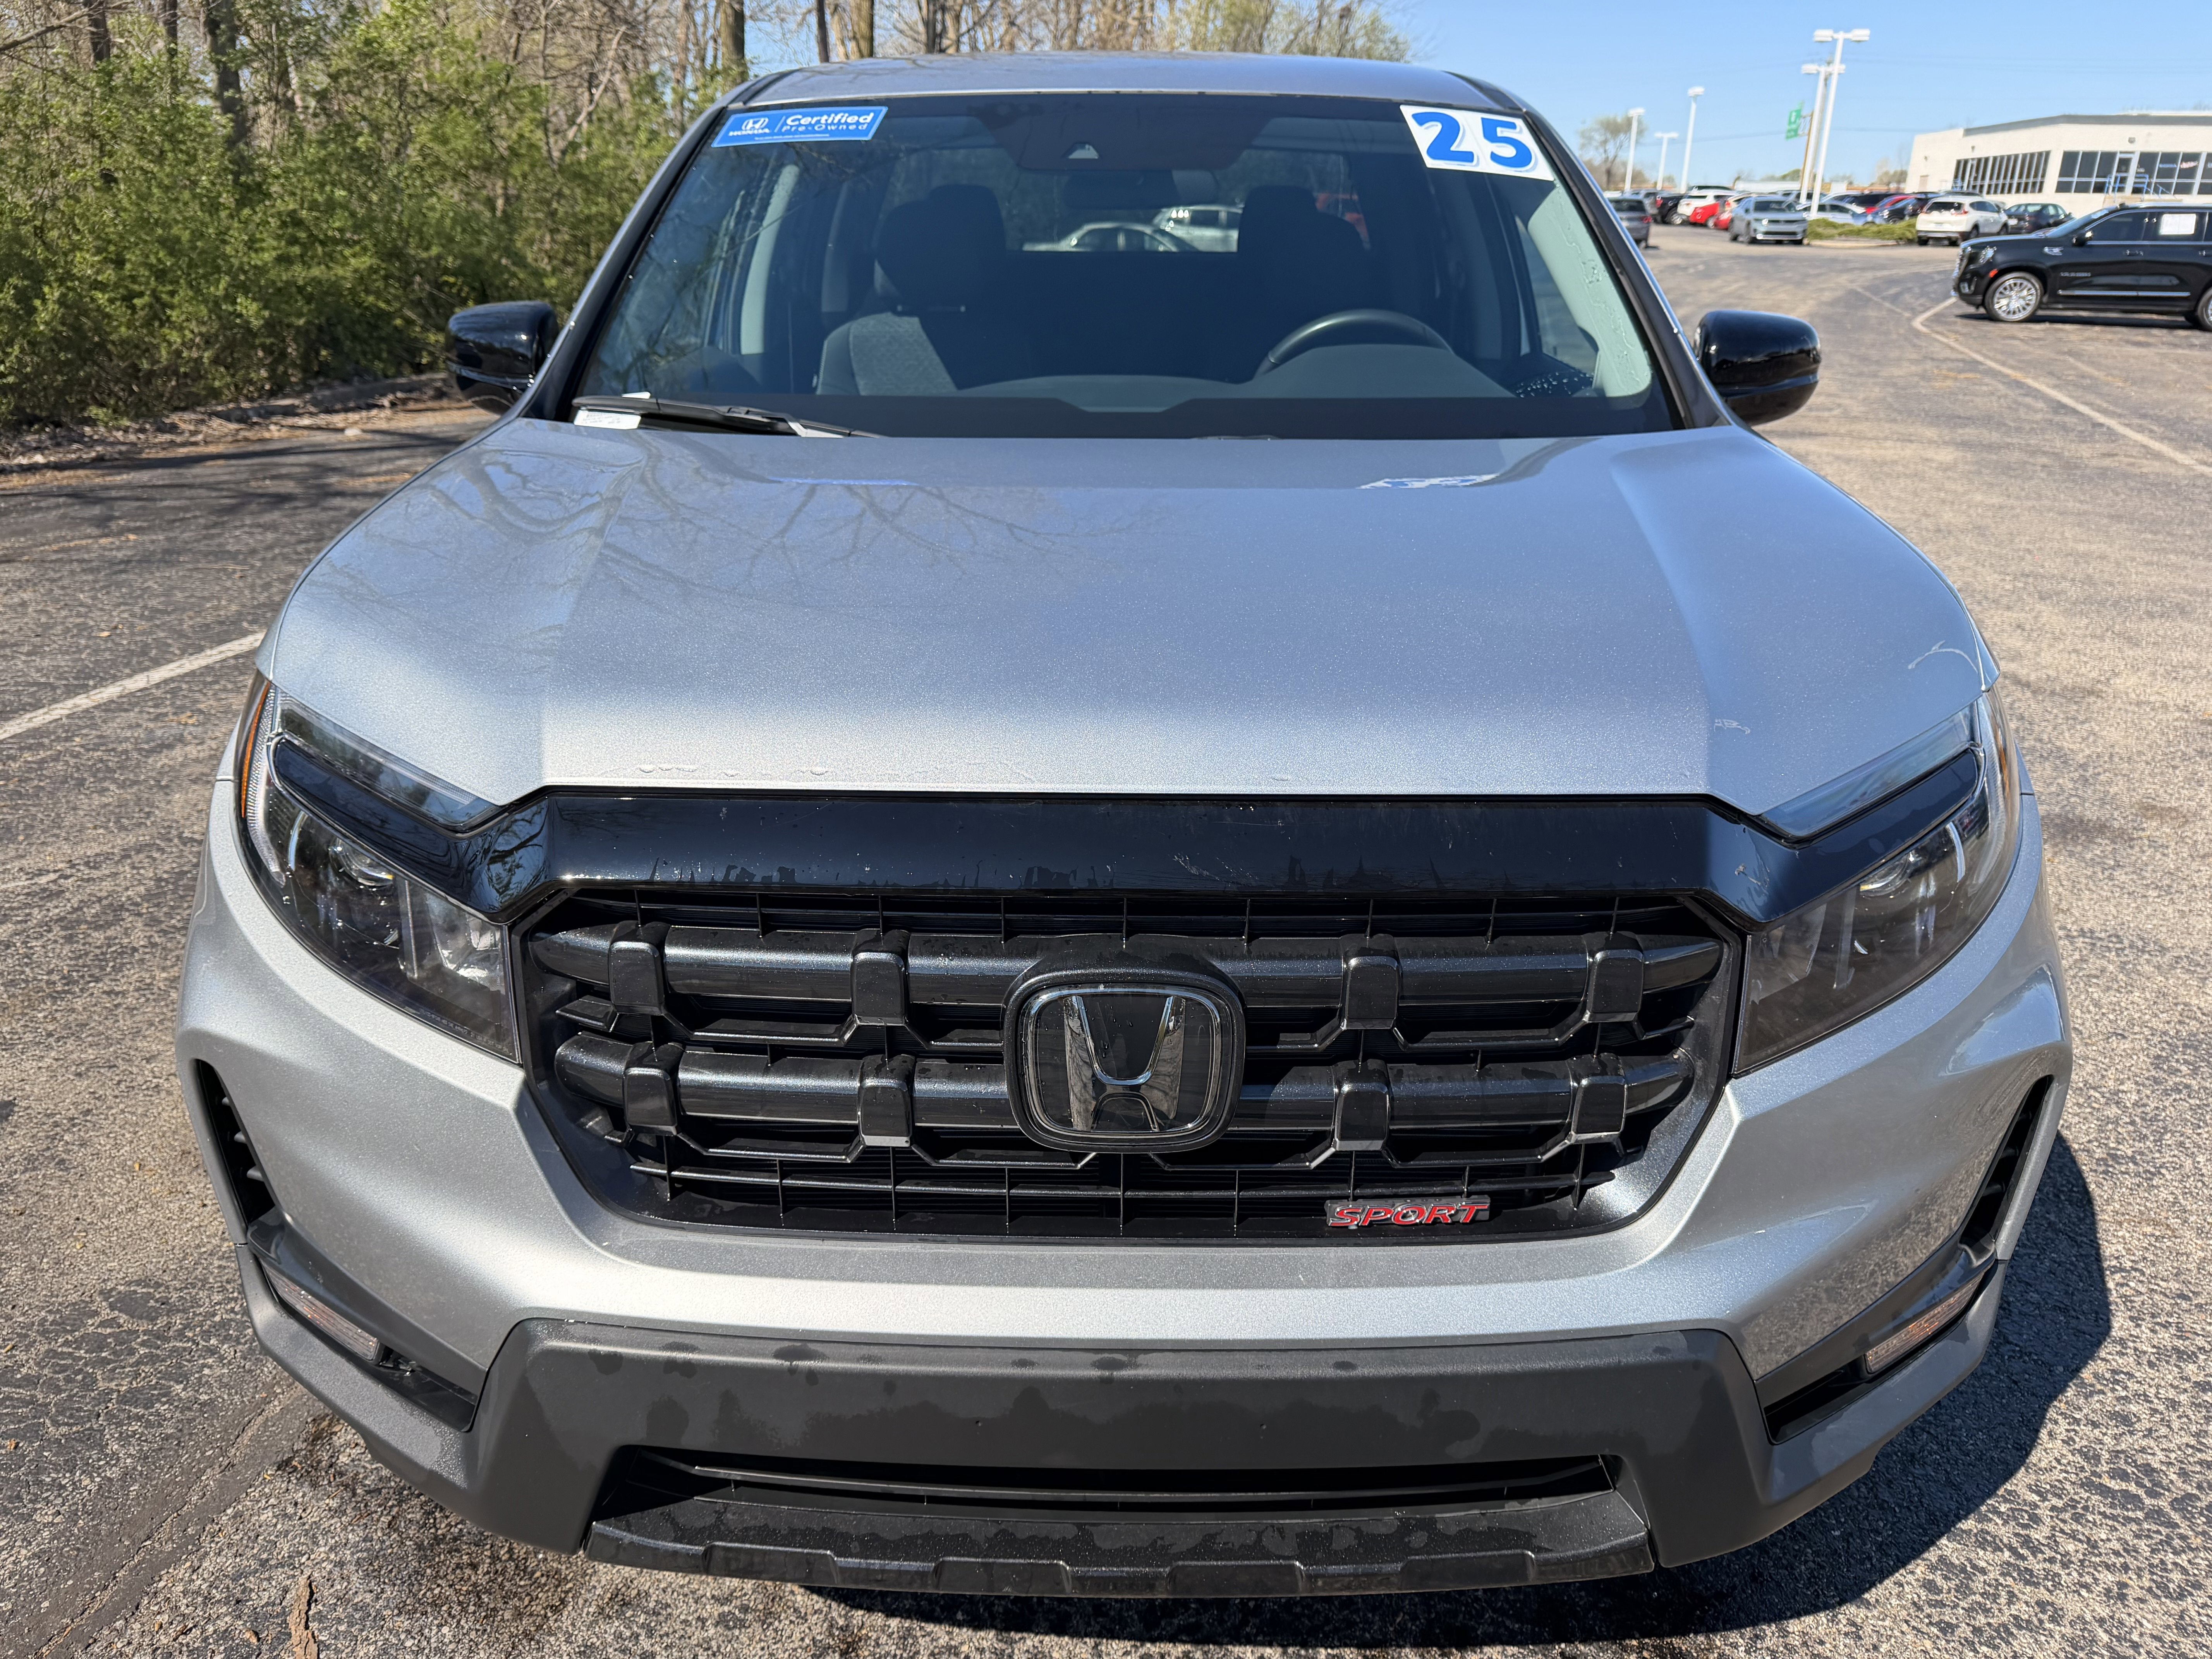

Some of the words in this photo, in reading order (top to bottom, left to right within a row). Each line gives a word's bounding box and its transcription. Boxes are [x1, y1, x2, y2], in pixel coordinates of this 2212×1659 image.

[781, 123, 868, 132] Pre-Owned
[786, 112, 874, 125] Certified
[1411, 112, 1532, 168] 25
[1328, 1202, 1489, 1226] SPORT
